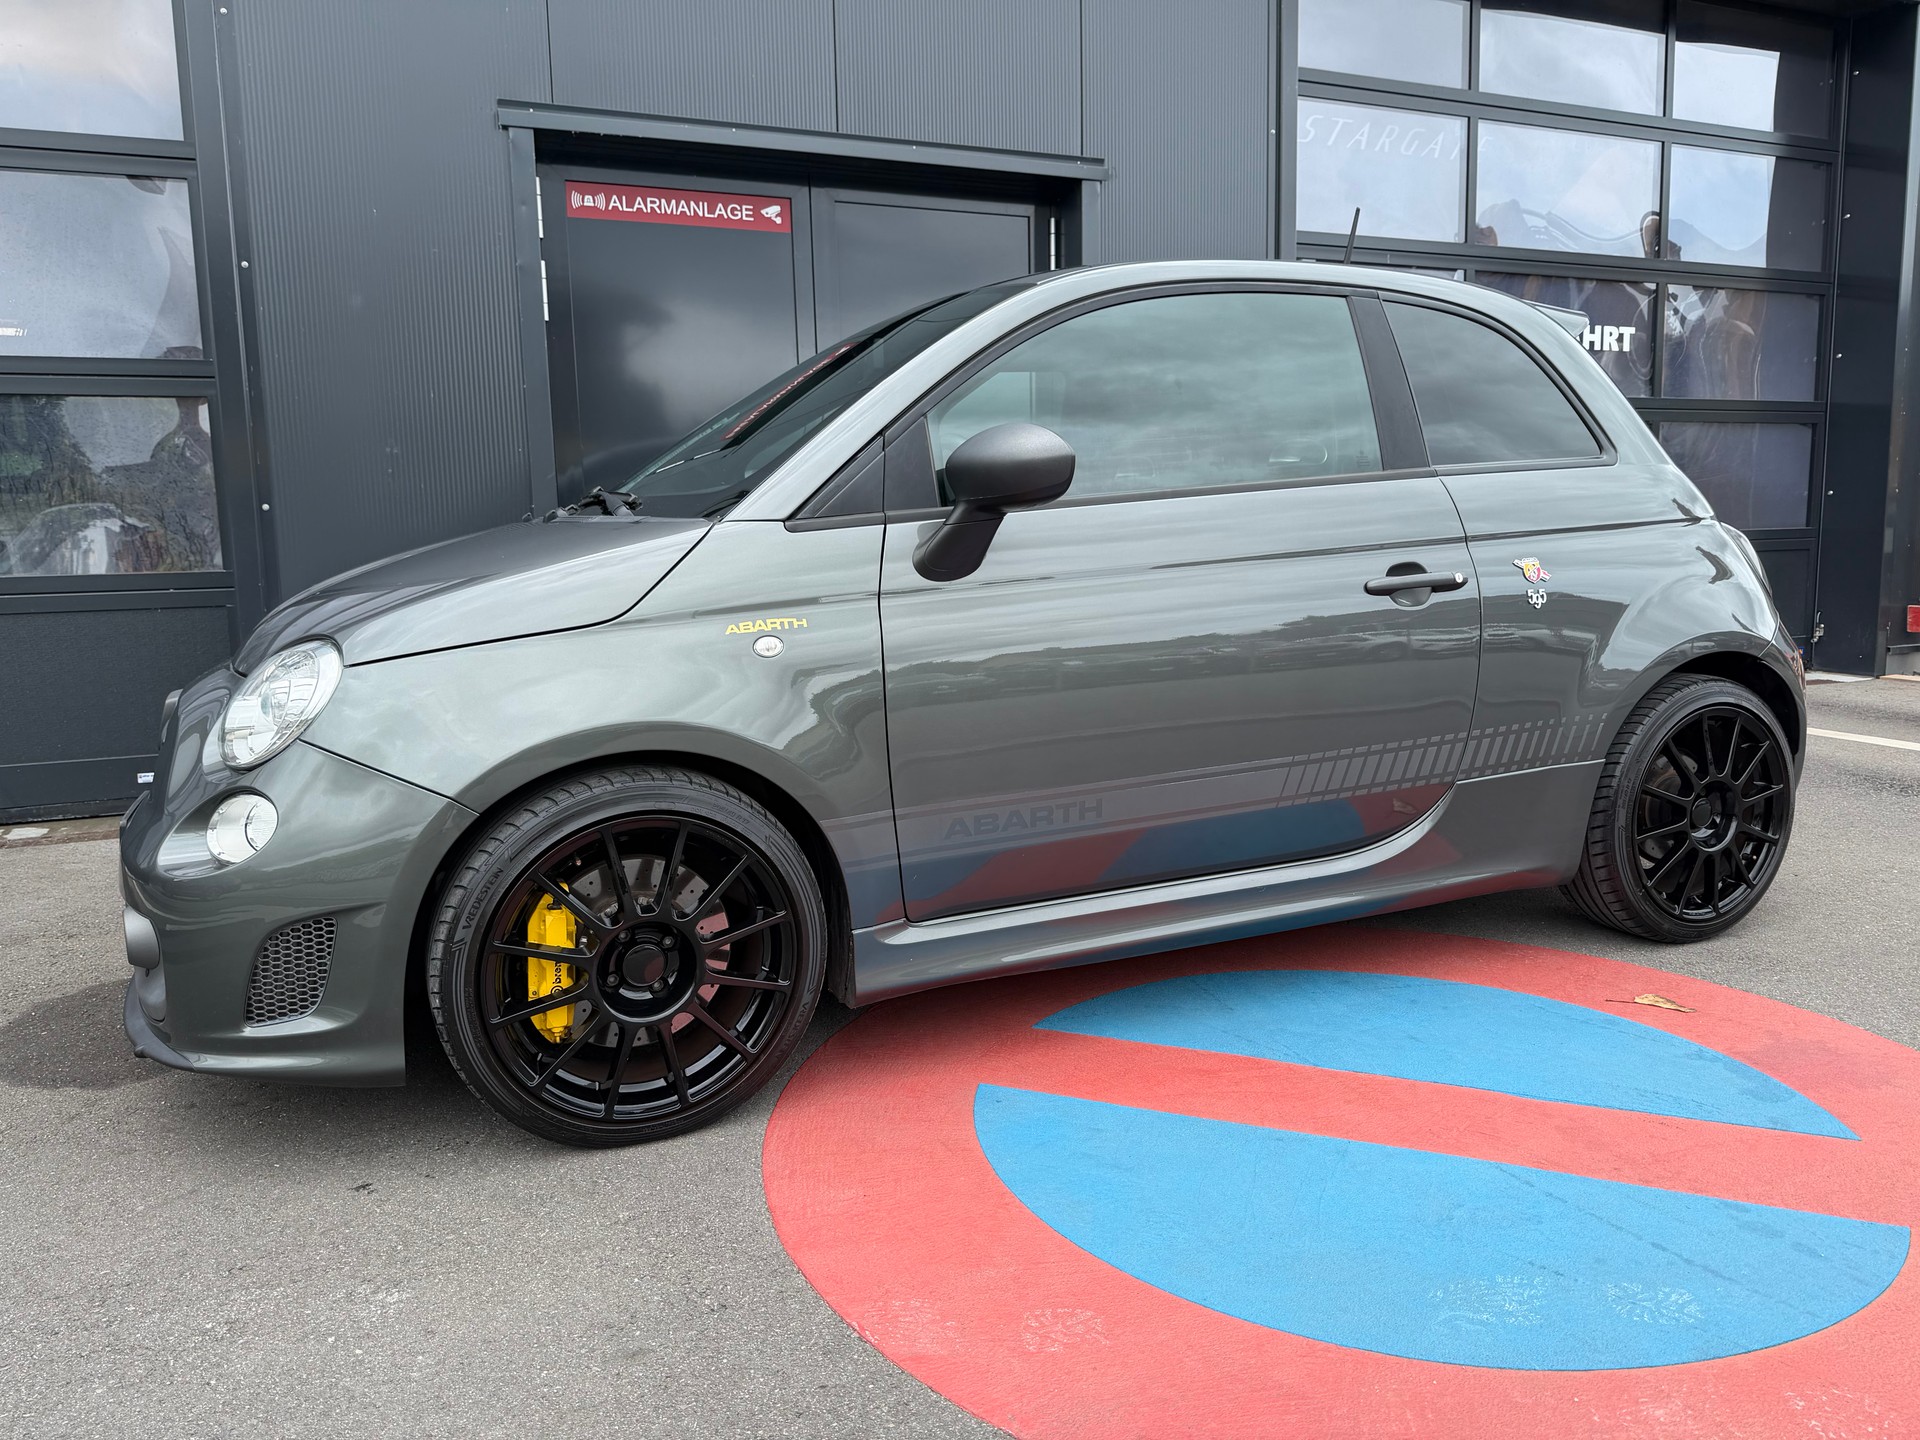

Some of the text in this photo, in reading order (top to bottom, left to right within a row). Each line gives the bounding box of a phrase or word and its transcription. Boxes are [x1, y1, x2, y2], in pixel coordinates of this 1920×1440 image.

[608, 194, 755, 221] ALARMANLAGE
[1577, 325, 1636, 352] HRT
[1526, 588, 1547, 609] 595
[725, 617, 808, 635] ABARTH
[943, 799, 1102, 840] ABARTH
[462, 866, 504, 930] VREDESTEIN
